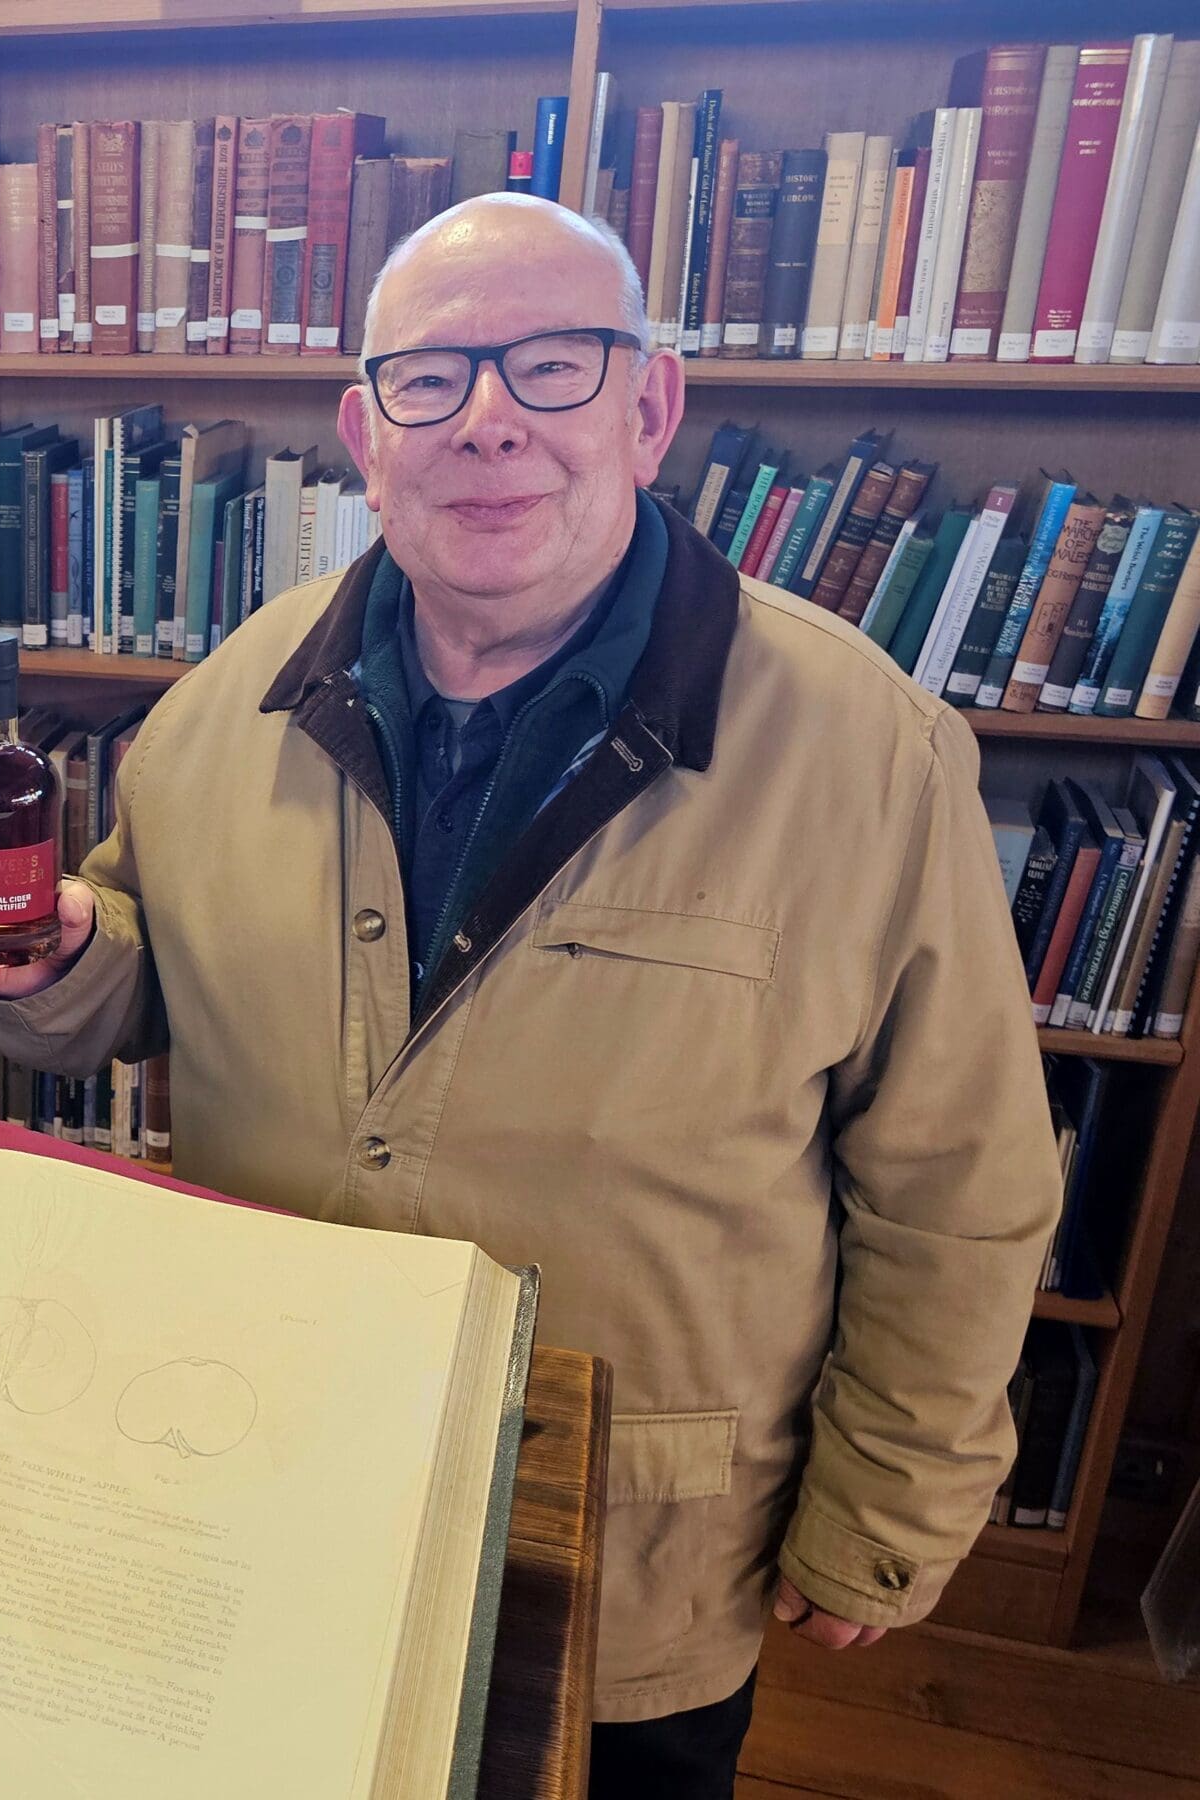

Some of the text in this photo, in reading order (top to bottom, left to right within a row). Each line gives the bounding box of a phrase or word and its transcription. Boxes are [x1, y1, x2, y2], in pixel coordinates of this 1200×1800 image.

[705, 132, 713, 143] the
[785, 174, 819, 184] HISTORY
[212, 166, 227, 306] DIRECTORY OF HEREFORDSHIRE
[1073, 518, 1093, 528] THE
[778, 524, 804, 576] VILLAGE
[1065, 538, 1086, 548] OF
[1054, 548, 1089, 563] WALES
[971, 553, 988, 585] Welsh
[957, 585, 976, 625] Marcher
[939, 624, 961, 671] Lordships
[88, 764, 96, 788] BOOK
[9, 893, 31, 903] CIDER
